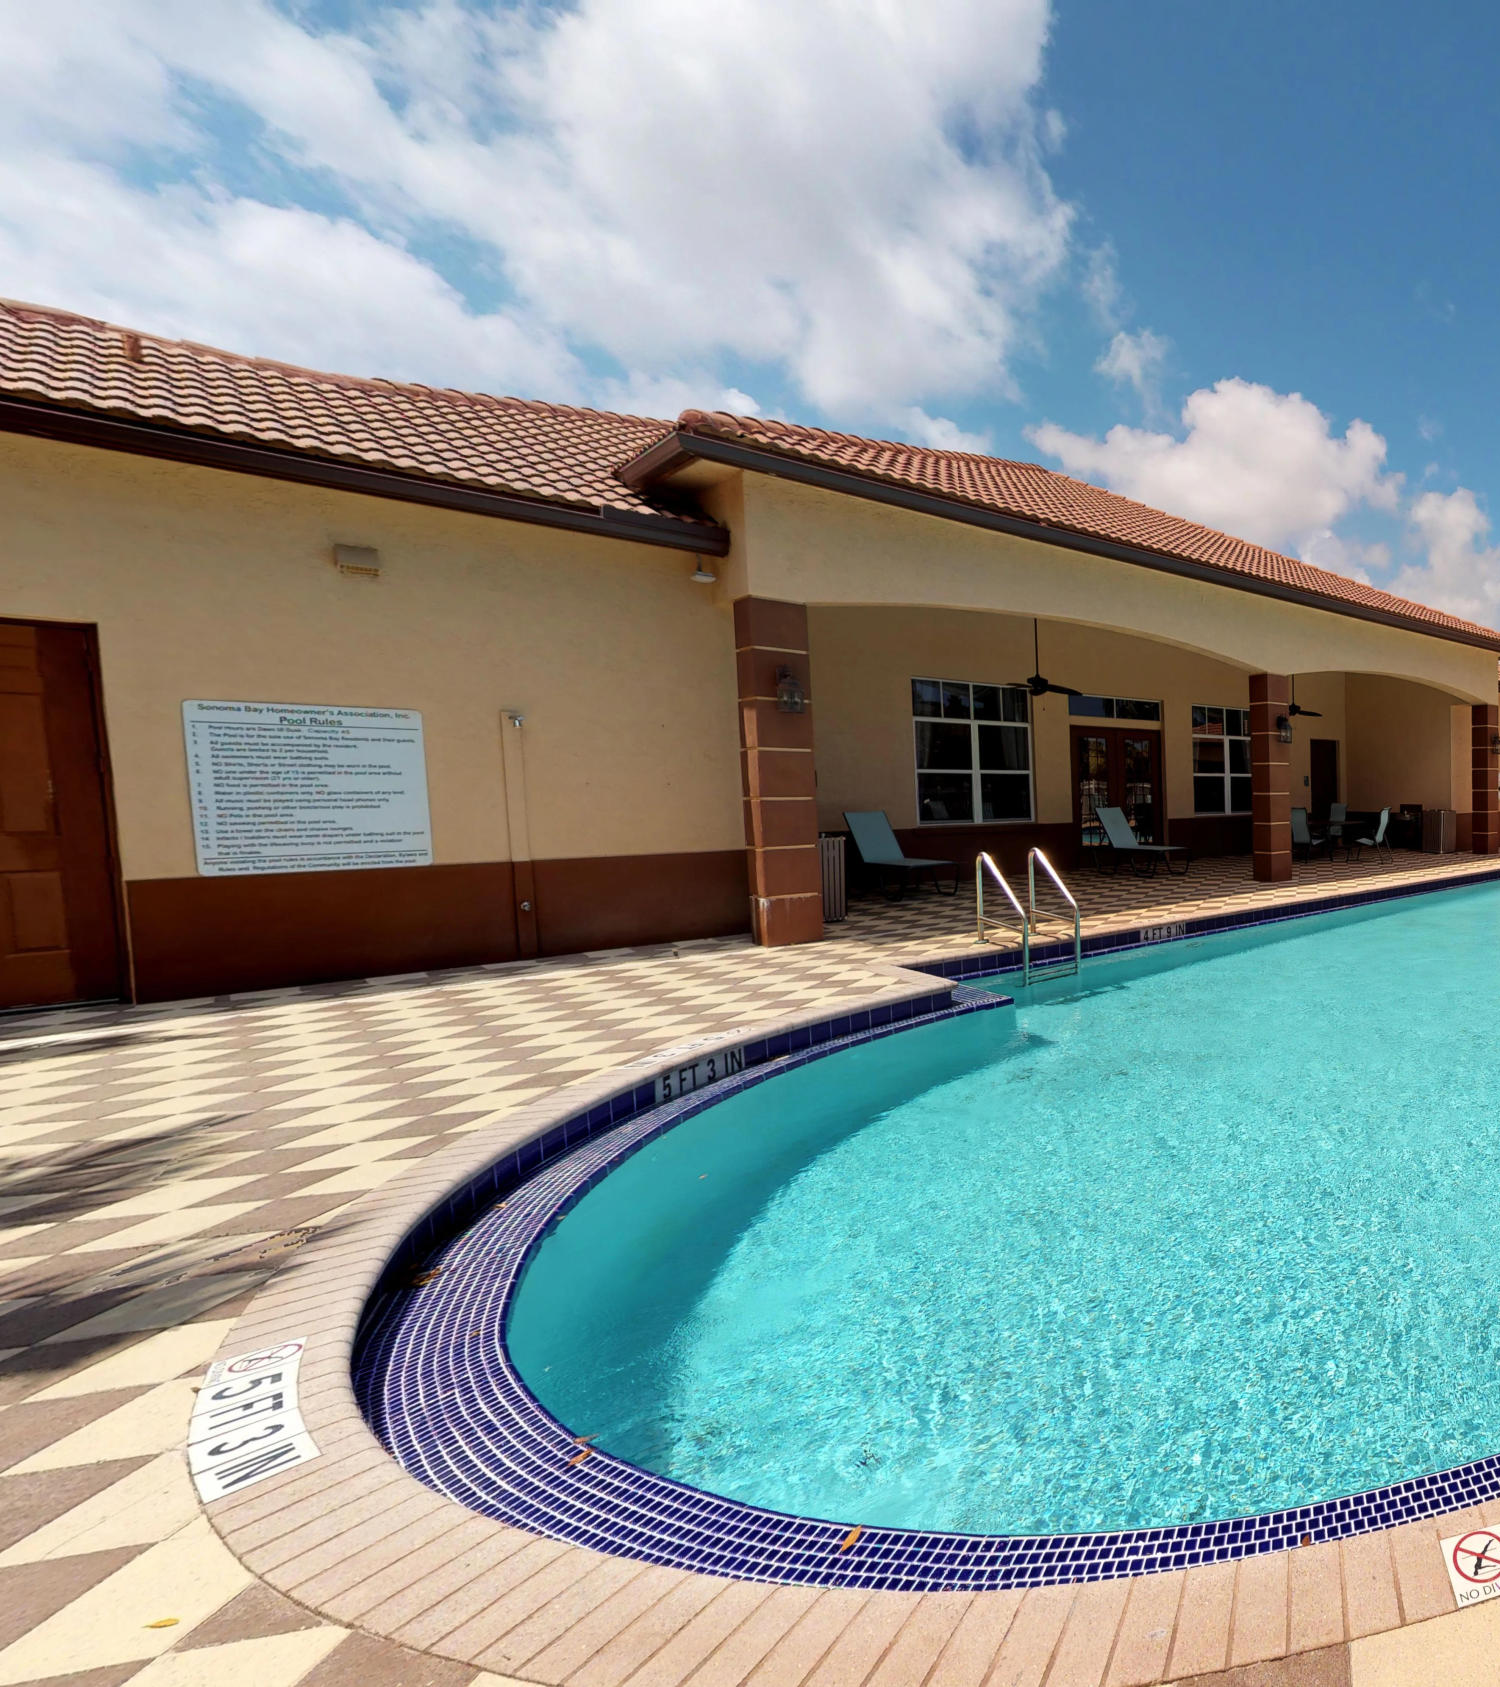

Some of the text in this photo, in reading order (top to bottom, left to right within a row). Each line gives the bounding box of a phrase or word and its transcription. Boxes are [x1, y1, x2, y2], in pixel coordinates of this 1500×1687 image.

[197, 704, 242, 712] Sonoma
[244, 706, 263, 714] Bay
[266, 706, 334, 716] Homeowner's
[337, 710, 393, 719] Association,
[280, 716, 343, 726] Pool Rules
[1152, 928, 1163, 940] FT
[1176, 924, 1184, 936] IN
[662, 1074, 672, 1098] 5
[679, 1064, 699, 1092] FT
[706, 1058, 716, 1080] 3
[724, 1048, 742, 1074] IN
[208, 1372, 302, 1490] 5 FT 3 IN
[1459, 1588, 1480, 1604] NO
